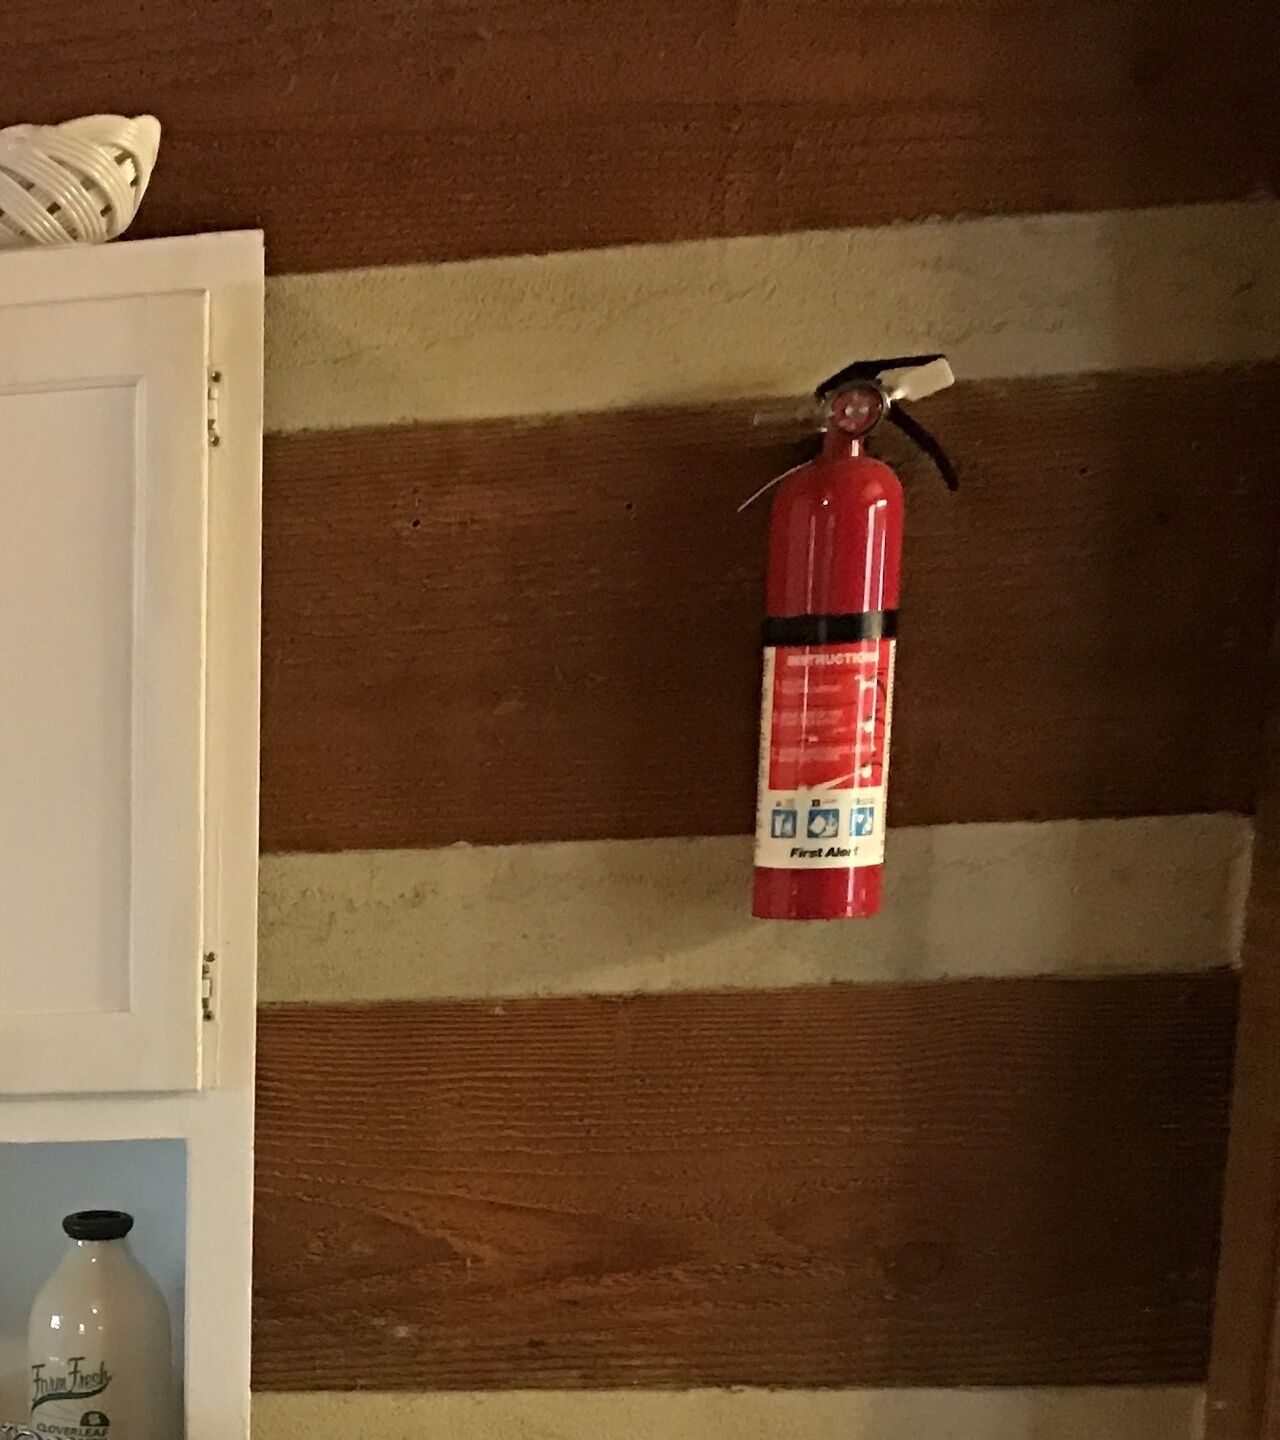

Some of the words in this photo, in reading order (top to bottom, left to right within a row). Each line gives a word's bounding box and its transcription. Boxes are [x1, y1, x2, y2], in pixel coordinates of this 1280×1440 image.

[790, 847, 823, 858] First
[825, 846, 859, 858] Alert
[32, 1363, 67, 1403] Farm
[67, 1356, 112, 1393] Fresh
